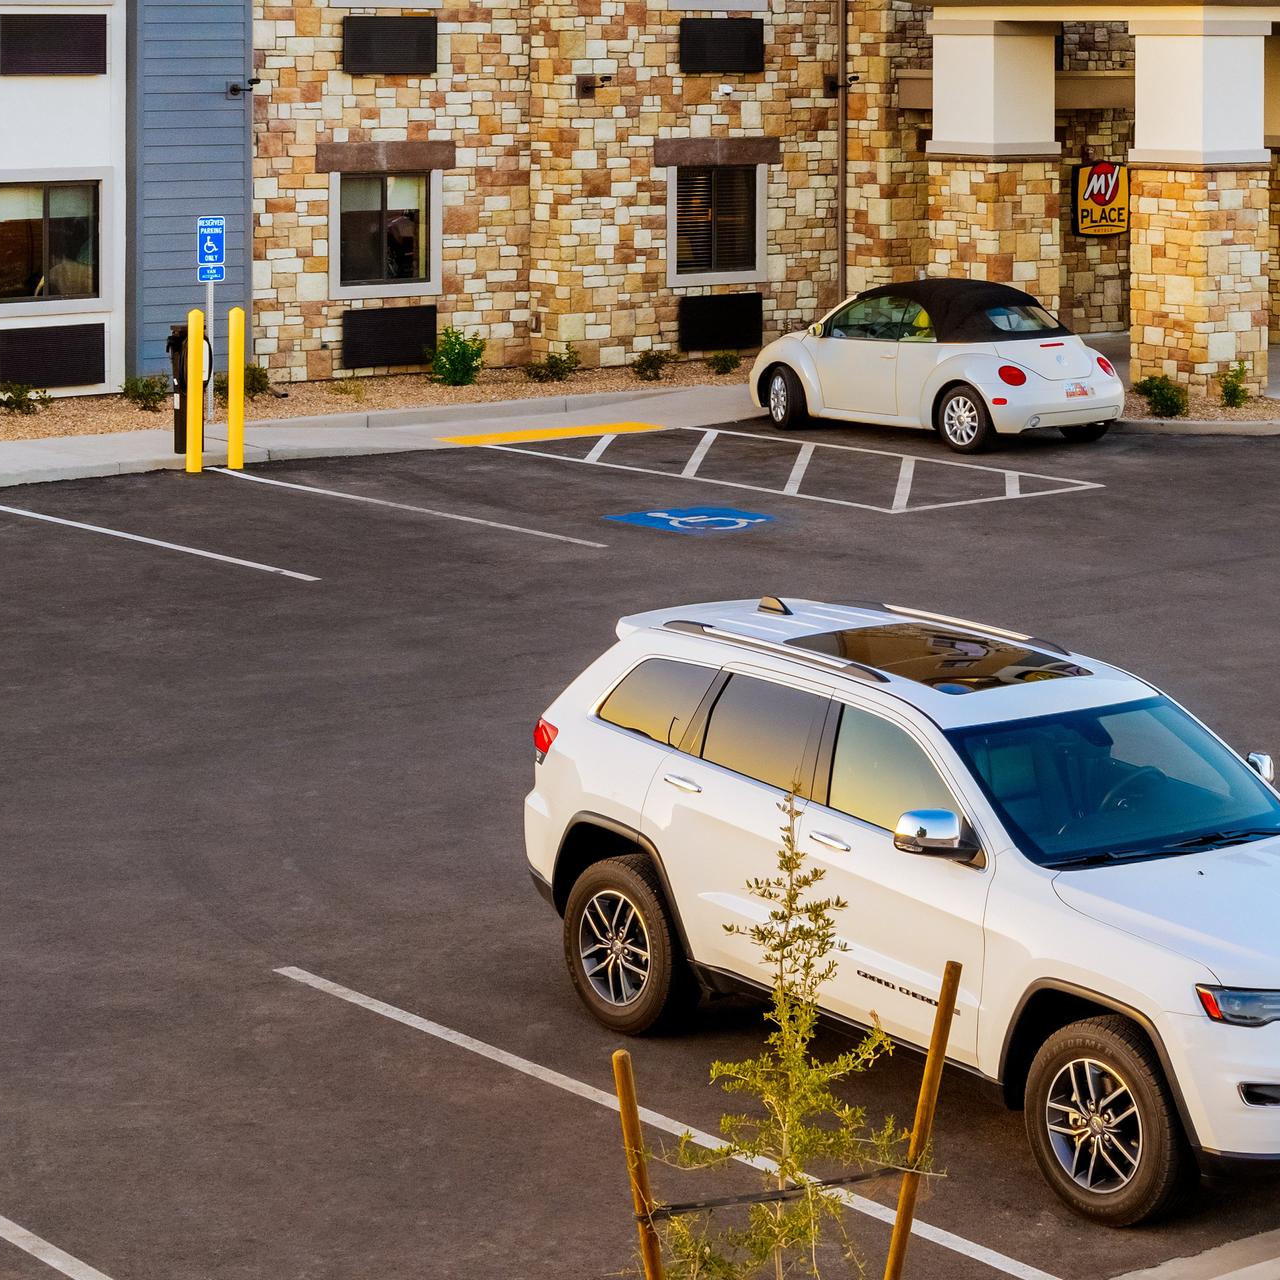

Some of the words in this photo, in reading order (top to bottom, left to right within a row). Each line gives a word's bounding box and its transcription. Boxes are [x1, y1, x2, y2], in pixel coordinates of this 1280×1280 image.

[1083, 164, 1120, 201] MY
[1080, 207, 1126, 225] PLACE
[198, 219, 224, 227] RESERVED
[200, 227, 223, 235] PARKING
[204, 254, 218, 262] ONLY
